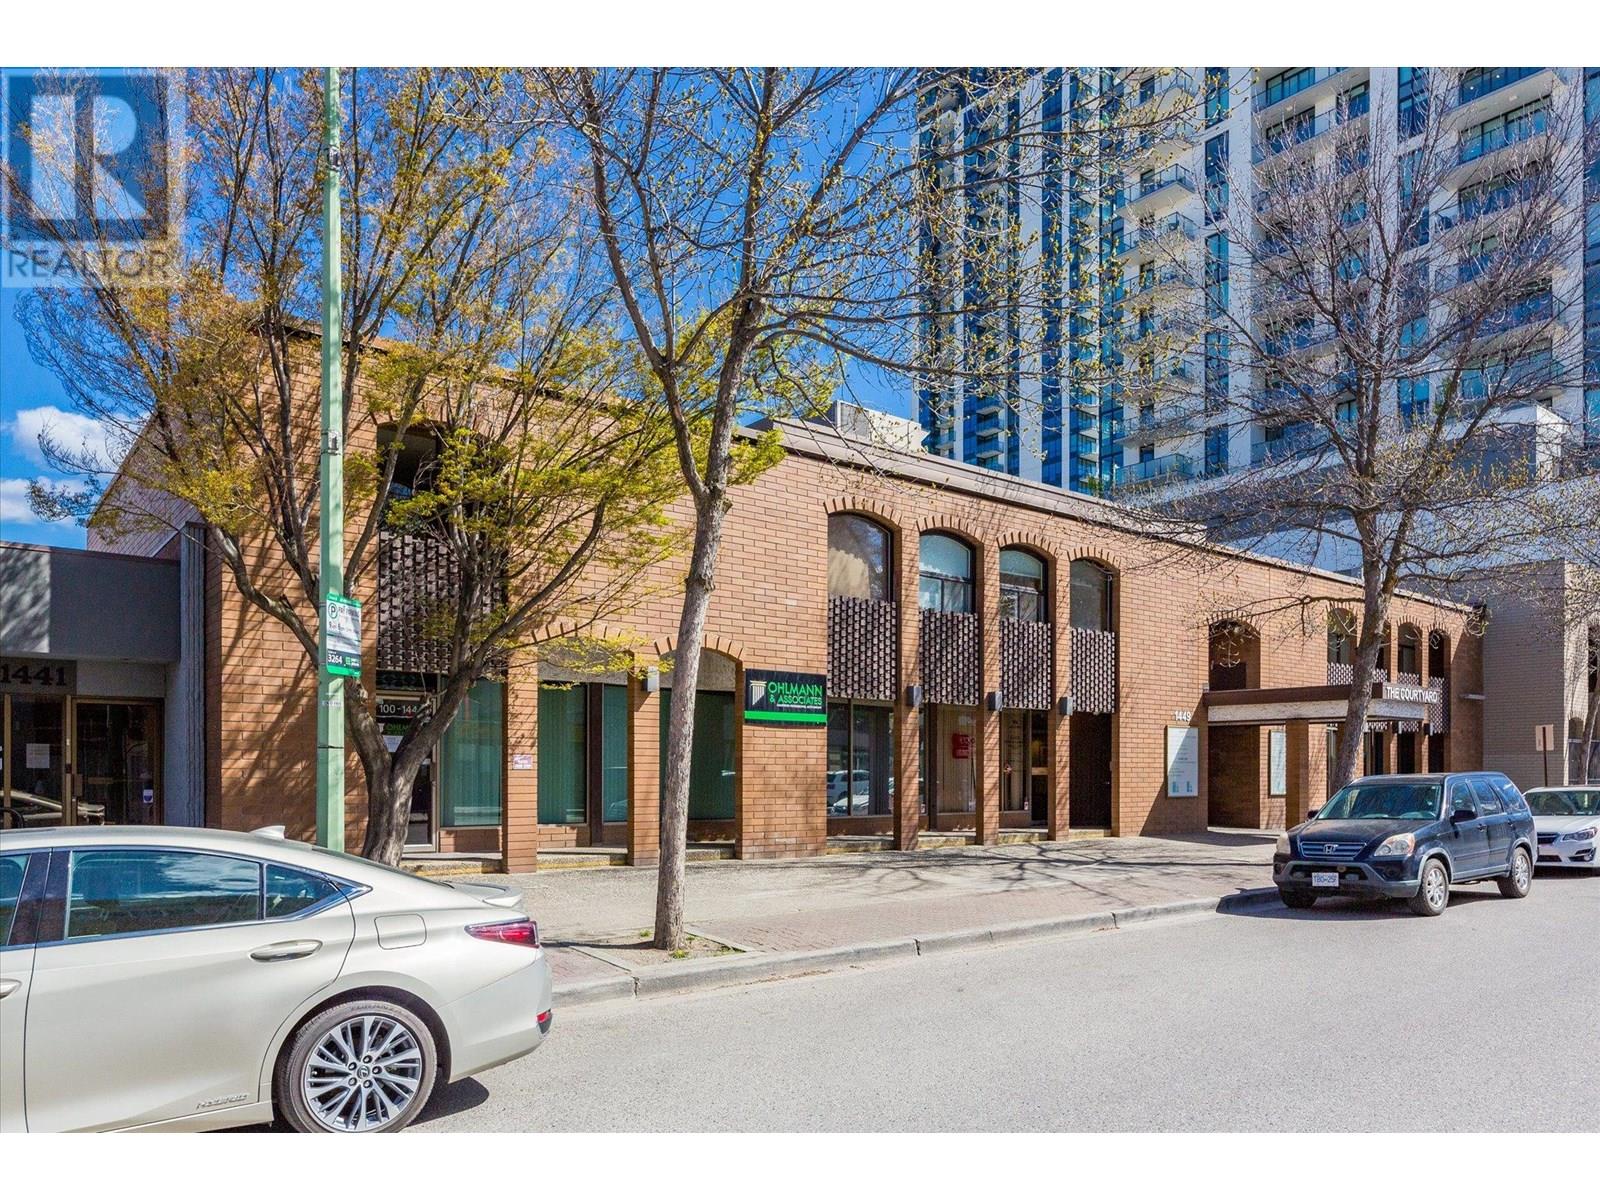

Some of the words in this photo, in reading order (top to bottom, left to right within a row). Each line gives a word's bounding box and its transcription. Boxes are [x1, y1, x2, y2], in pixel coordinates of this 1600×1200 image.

[0, 663, 67, 686] 1441
[767, 681, 823, 697] OHLMANN
[1386, 686, 1400, 700] THE
[1400, 688, 1438, 703] COURTYARD
[769, 694, 776, 704] &
[777, 694, 823, 706] ASSOCIATES
